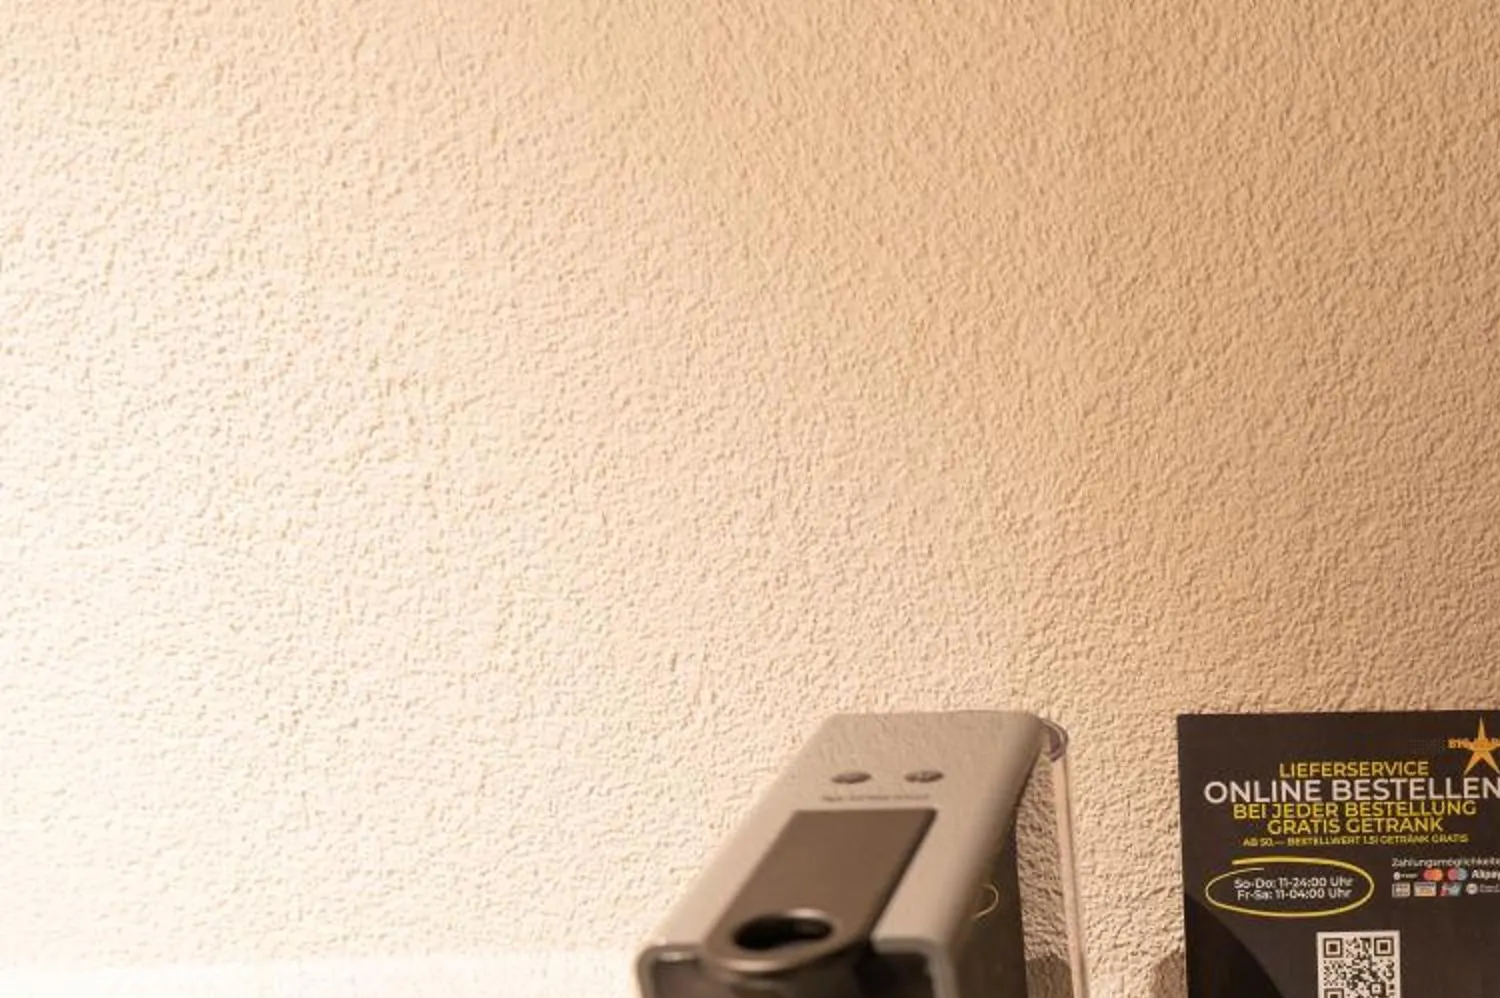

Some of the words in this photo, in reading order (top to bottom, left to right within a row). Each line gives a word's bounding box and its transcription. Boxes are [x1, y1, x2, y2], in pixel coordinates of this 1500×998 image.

[1279, 761, 1429, 778] LIEFERSERVICE
[1203, 779, 1322, 803] ONLINE
[1233, 802, 1267, 819] BEI
[1271, 802, 1339, 818] JEDER
[1345, 799, 1477, 818] BESTELLUNG
[1267, 819, 1341, 835] GRATIS
[1278, 876, 1327, 889] 11-24:00
[1329, 876, 1353, 887] Uhr
[1237, 889, 1272, 900] Fr-Sa:
[1275, 887, 1325, 900] 11-04:00
[1328, 887, 1352, 898] Uhr
